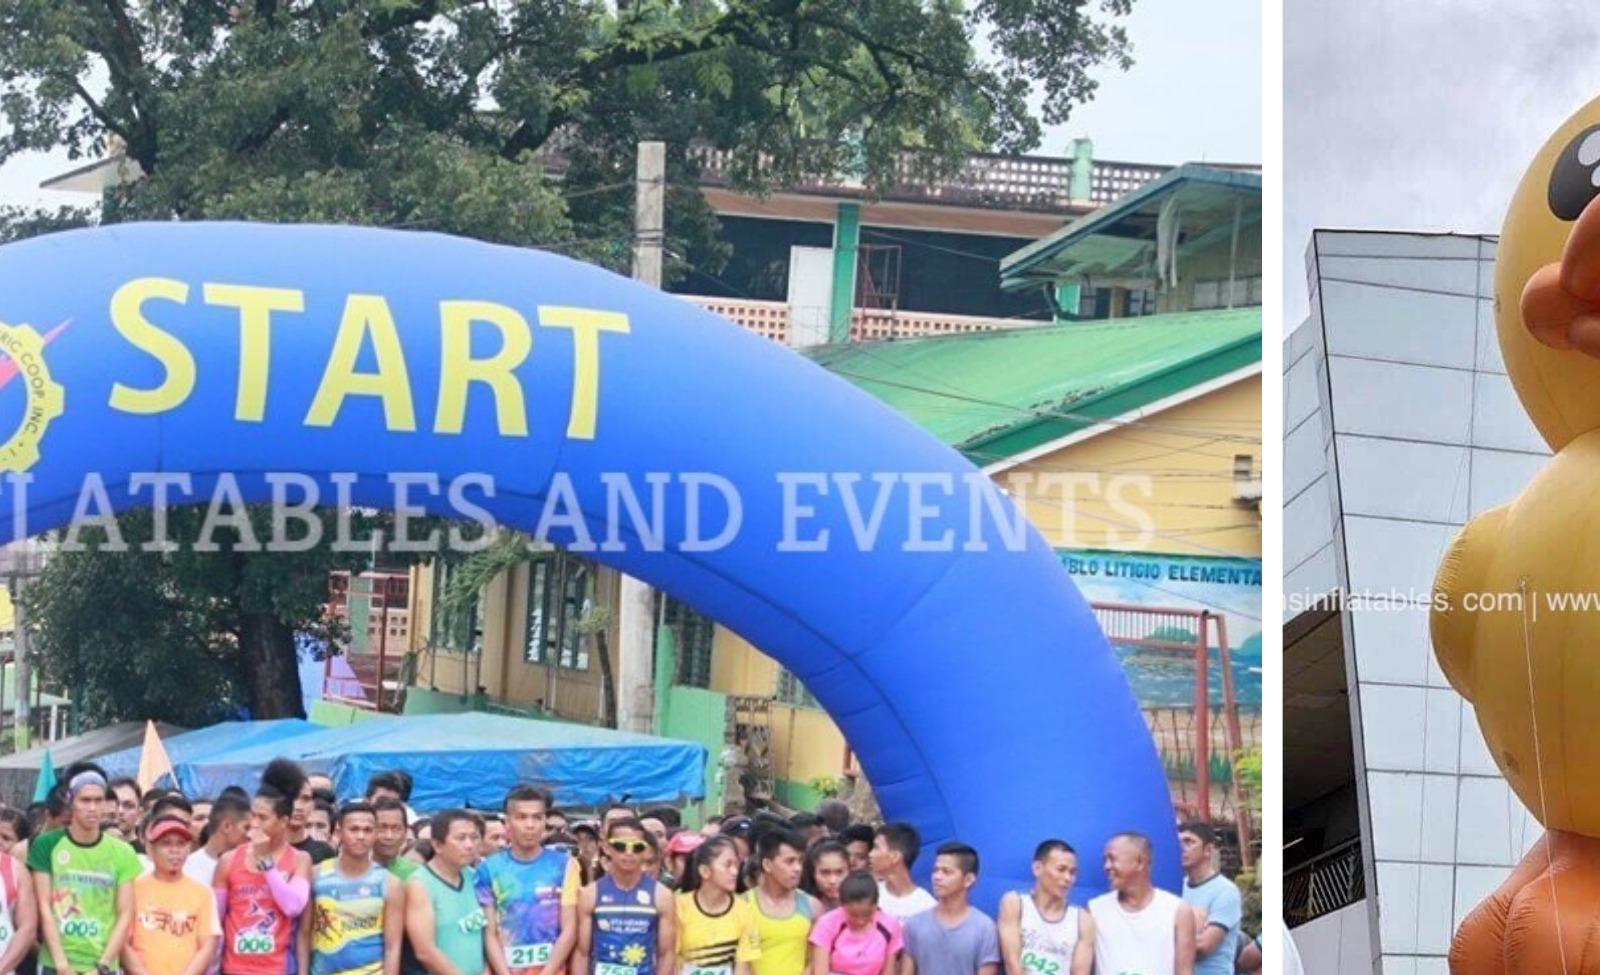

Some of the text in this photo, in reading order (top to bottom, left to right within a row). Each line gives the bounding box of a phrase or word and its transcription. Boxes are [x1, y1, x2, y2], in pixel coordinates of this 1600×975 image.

[107, 276, 631, 442] START
[238, 937, 273, 952] 006
[512, 947, 550, 965] 215
